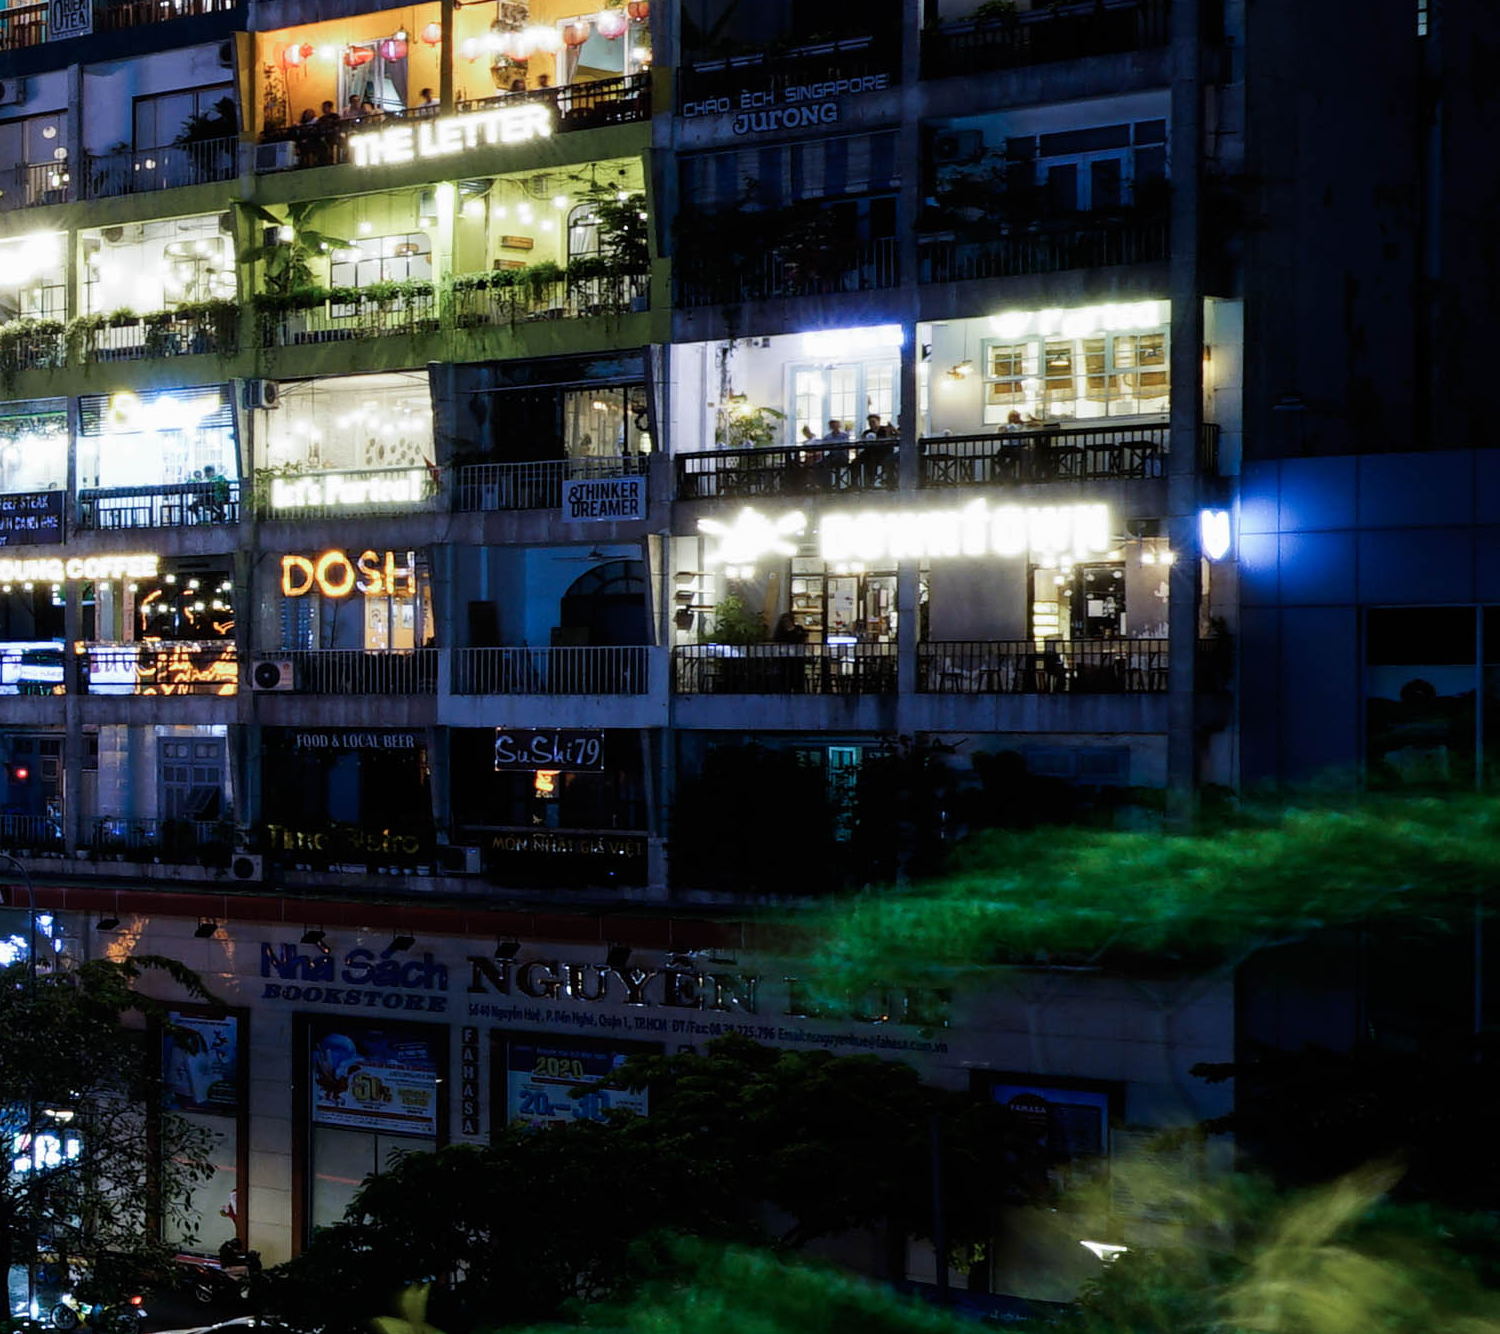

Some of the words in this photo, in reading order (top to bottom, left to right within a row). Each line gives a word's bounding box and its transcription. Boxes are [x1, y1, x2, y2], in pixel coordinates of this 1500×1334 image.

[62, 13, 86, 29] TEA
[784, 74, 891, 104] SINGAPORE
[350, 127, 414, 166] THE
[418, 104, 551, 158] LETTER
[577, 479, 639, 501] THINKER
[571, 498, 639, 518] DREAMER
[66, 555, 160, 579] COFFEE
[281, 549, 417, 597] DOSH
[296, 734, 329, 749] FOOD
[330, 734, 341, 749] &
[342, 733, 382, 749] LOCAL
[383, 733, 416, 749] BEER
[259, 939, 335, 982] Nhà
[340, 944, 449, 992] Sách
[466, 946, 759, 1014] NGUYỄN
[261, 982, 448, 1013] BOOKSTORE
[461, 1027, 479, 1135] FAHASA
